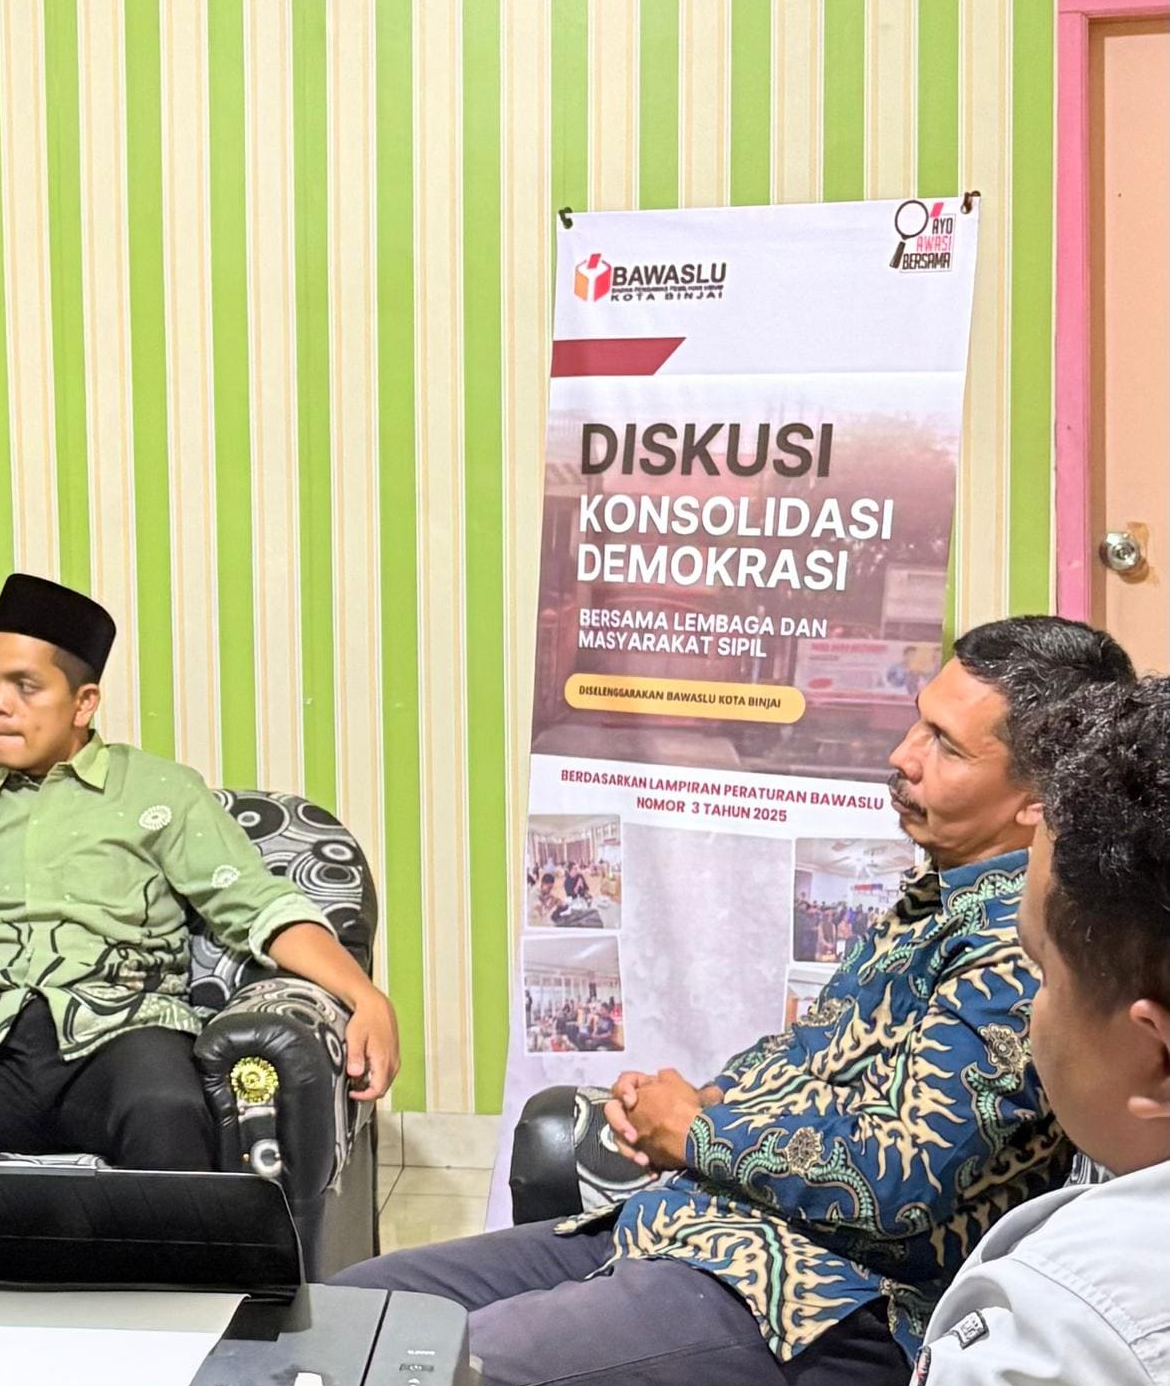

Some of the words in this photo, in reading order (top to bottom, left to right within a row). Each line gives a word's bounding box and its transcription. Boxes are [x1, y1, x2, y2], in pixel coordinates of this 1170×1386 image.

[932, 217, 953, 234] AYO
[916, 235, 952, 253] AWASI
[902, 252, 951, 270] BERSAMA
[612, 262, 727, 286] BAWASLU
[611, 293, 655, 302] KOTA
[664, 291, 723, 300] BINJAI
[581, 422, 834, 478] DISKUSI
[578, 493, 894, 540] KONSOLIDASI
[576, 544, 849, 592] DEMOKRASI
[580, 608, 669, 630] BERSAMA
[673, 613, 775, 636] LEMBAGA
[780, 617, 828, 638] DAN
[578, 630, 713, 654] MASYARAKAT
[717, 637, 767, 658] SIPIL
[579, 685, 664, 701] DISELENGGARAKAN
[666, 691, 716, 704] BAWASLU
[718, 695, 746, 707] KOTA
[748, 697, 781, 709] BINJAI
[561, 769, 647, 790] BERDASARKAN
[649, 776, 721, 796] LAMPIRAN
[724, 784, 807, 804] PERATURAN
[810, 792, 884, 811] BAWASLU
[637, 797, 685, 813] NOMOR
[691, 801, 700, 814] 3
[704, 803, 751, 819] TAHUN
[753, 807, 787, 822] 2025
